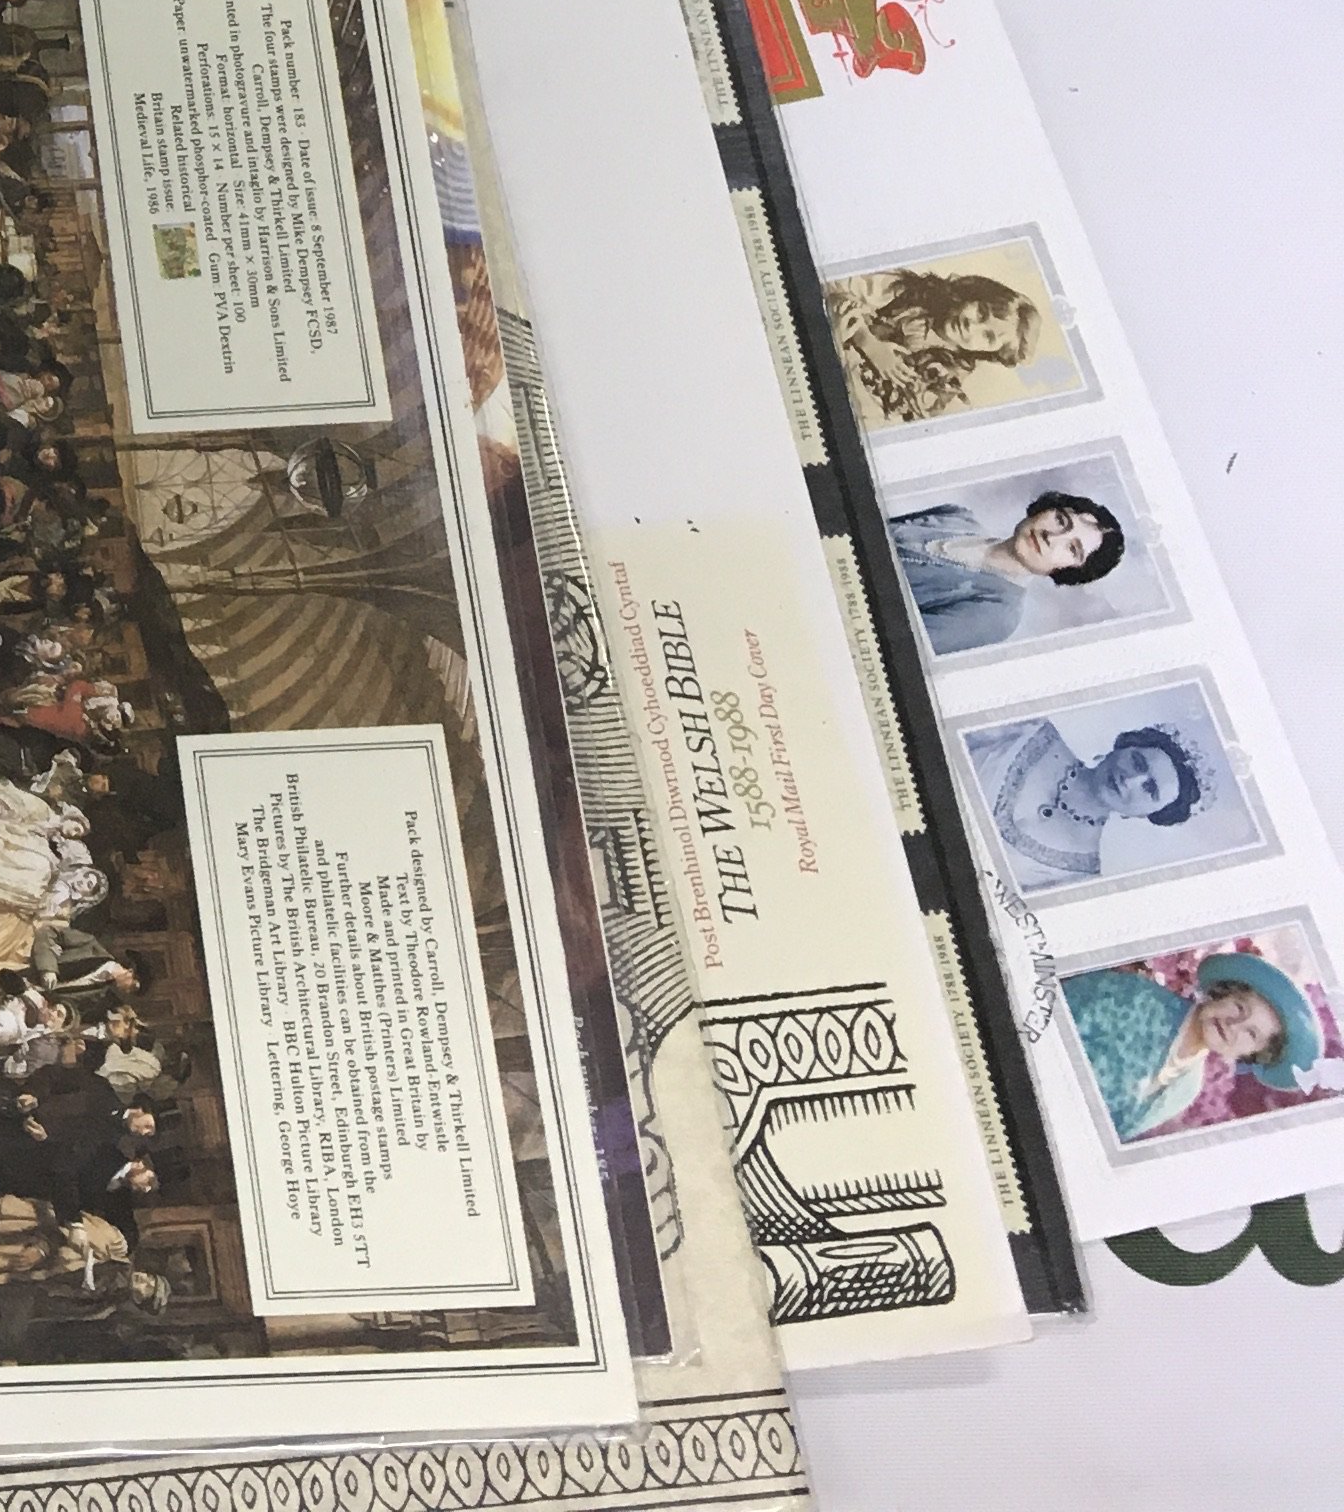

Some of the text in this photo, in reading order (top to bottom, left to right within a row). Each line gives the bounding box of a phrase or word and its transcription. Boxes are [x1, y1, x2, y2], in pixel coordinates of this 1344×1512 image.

[651, 599, 759, 924] THE WELSH BIBLE
[709, 690, 773, 831] 1588-1988
[745, 628, 819, 874] Royal Mail First Day Cover
